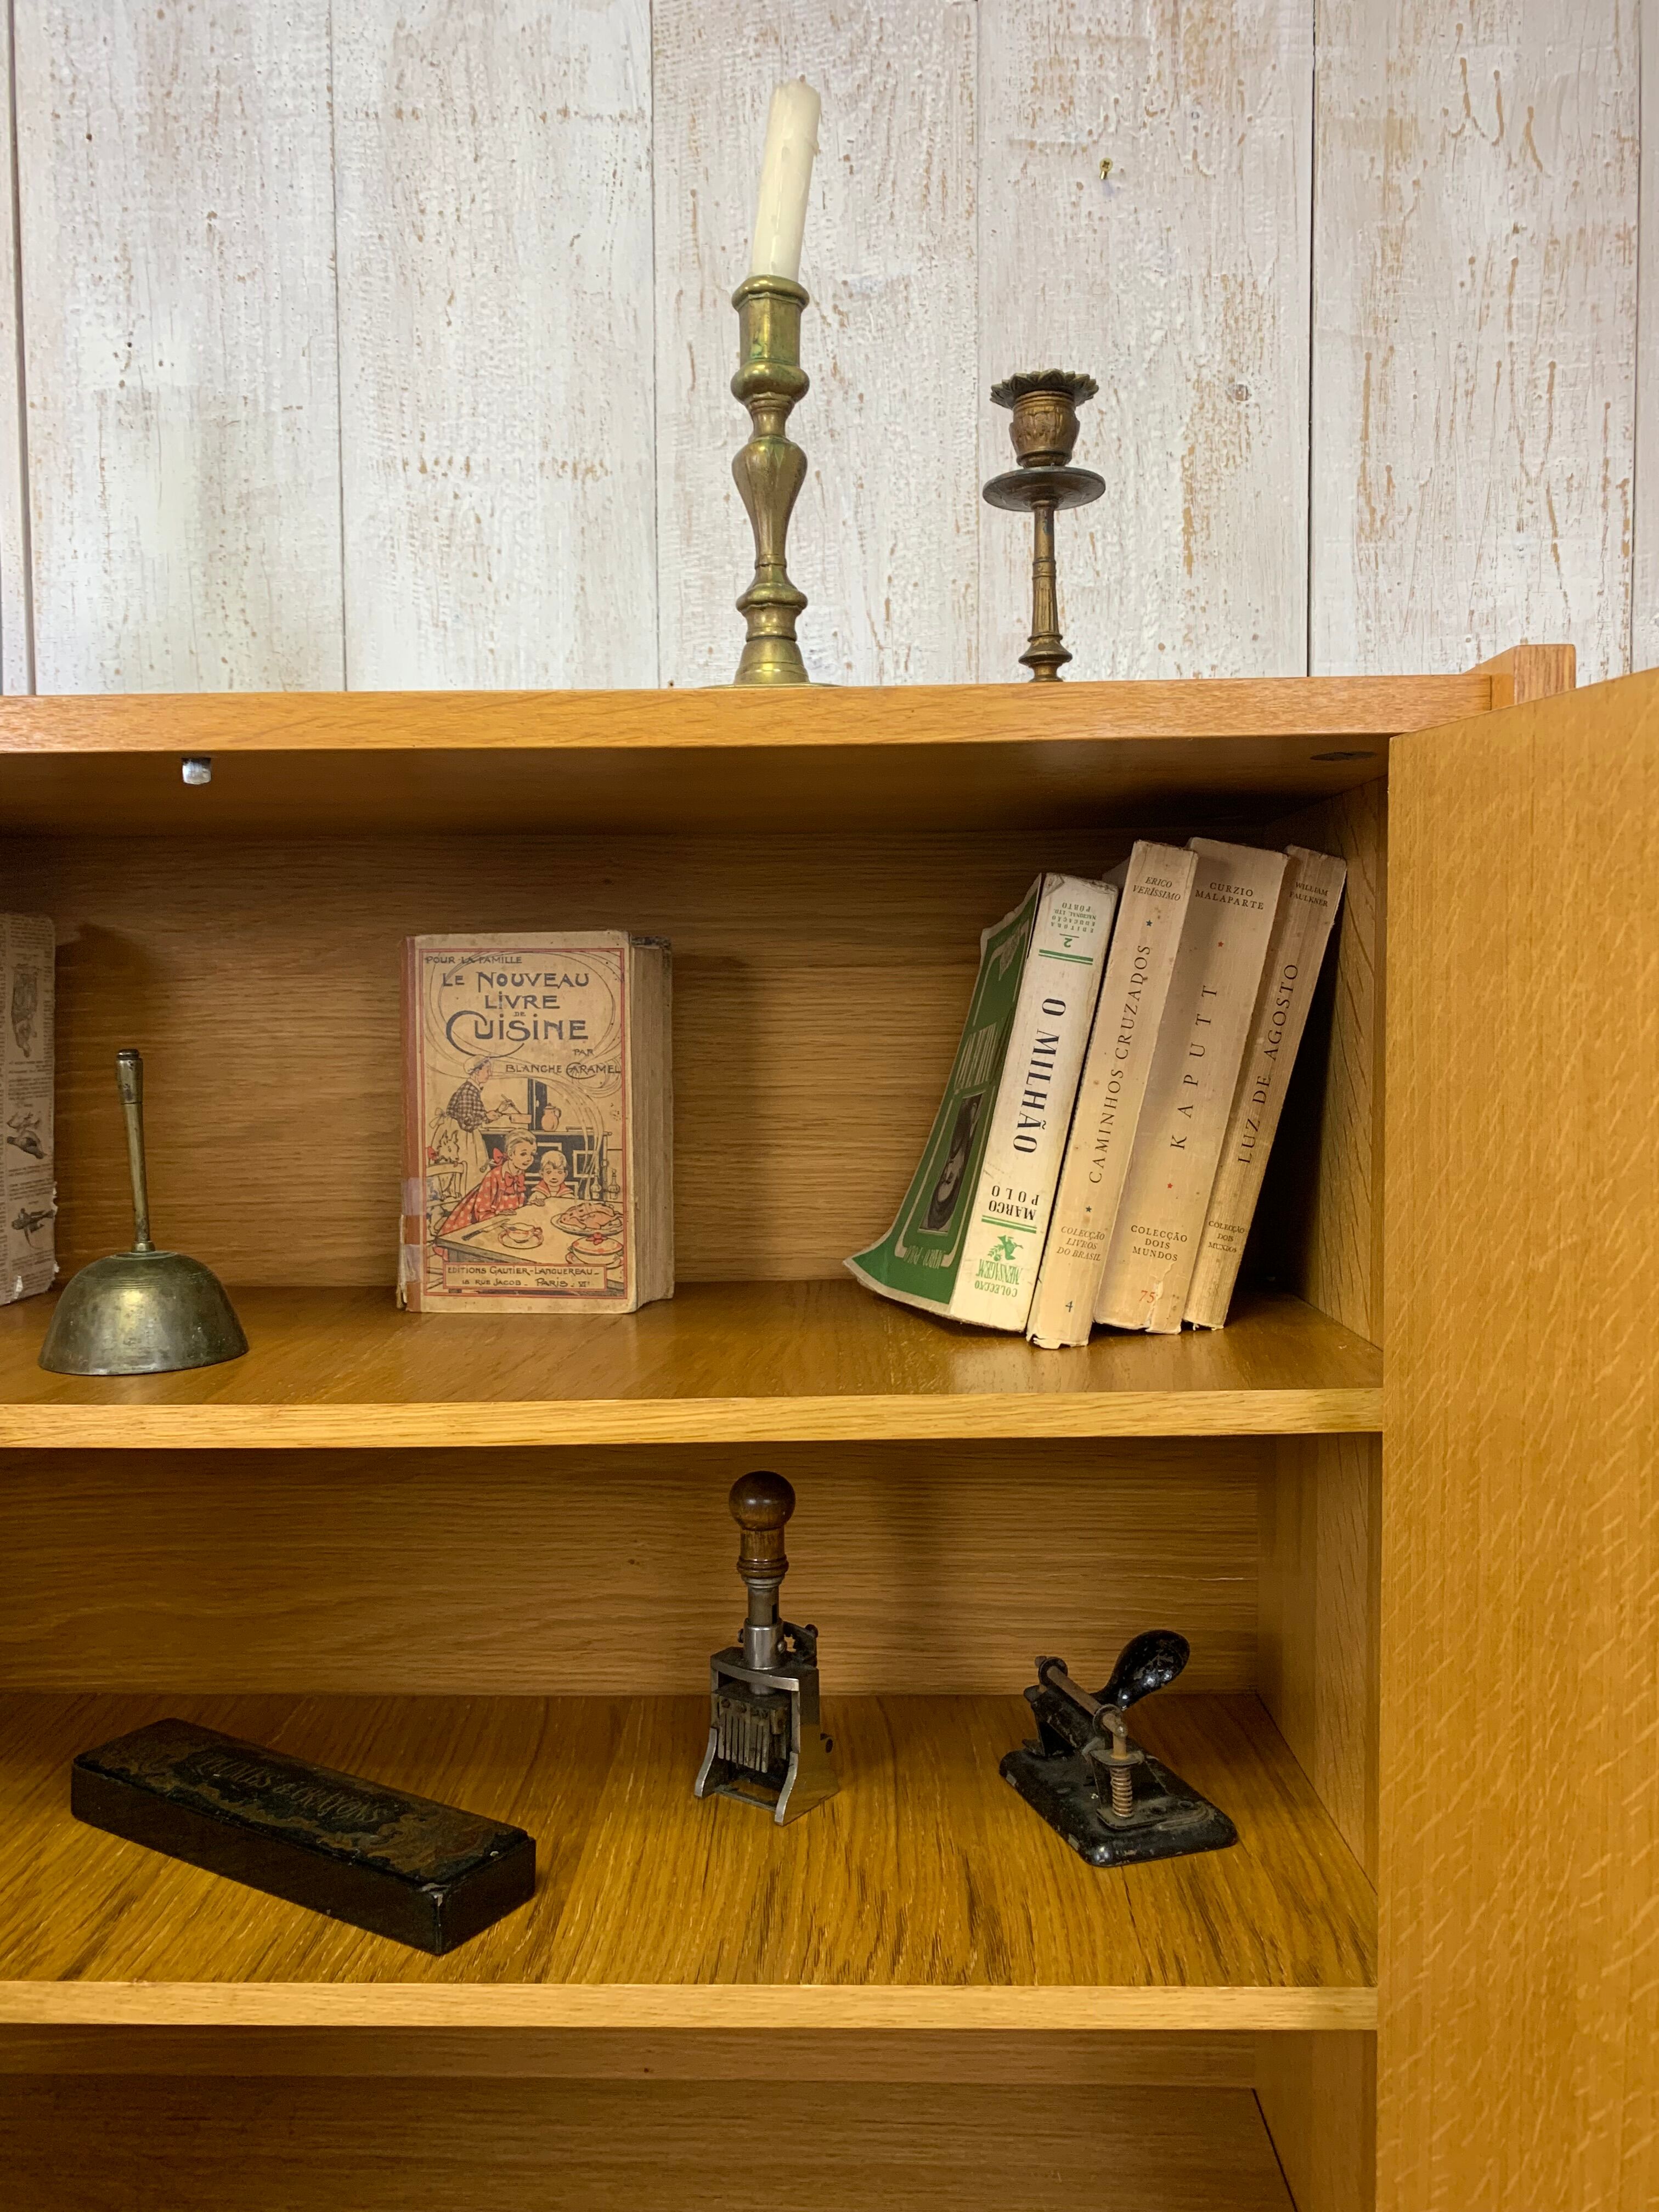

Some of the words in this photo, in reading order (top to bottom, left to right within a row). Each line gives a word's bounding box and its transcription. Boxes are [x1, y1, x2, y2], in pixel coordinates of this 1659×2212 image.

[1144, 876, 1172, 888] ERICO
[1209, 882, 1254, 897] CURZIO
[1295, 881, 1329, 896] WILLIAM
[1132, 884, 1181, 901] VERÍSSIMO
[1195, 889, 1264, 910] MALAPARTE
[1289, 891, 1328, 907] FAULKNER
[1069, 911, 1097, 920] NACIONAL
[1051, 922, 1094, 933] EDITORA
[1063, 937, 1073, 948] 2
[425, 956, 455, 964] POUR
[442, 973, 465, 987] LE
[476, 972, 590, 993] NOUVEAU
[484, 991, 560, 1009] LIVRE
[1042, 998, 1066, 1016] O
[445, 1010, 589, 1058] CUISINE
[573, 1048, 595, 1057] PAR
[505, 1064, 562, 1073] BLANCHE
[1088, 1068, 1124, 1183] CAMINHOS
[1114, 945, 1150, 1059] CRUZADOS
[1238, 1118, 1261, 1164] LUZ
[1252, 1075, 1272, 1104] DE
[1263, 964, 1298, 1061] AGOSTO
[1013, 1028, 1060, 1153] MILHÃO
[991, 1185, 1040, 1206] POLO
[989, 1200, 1037, 1221] MARCO
[1060, 1225, 1105, 1241] COLECÇÃO
[1130, 1224, 1188, 1243] COLECÇÃO
[1216, 1233, 1234, 1242] DOIS
[1065, 1238, 1098, 1250] LIVROS
[1144, 1238, 1171, 1250] DOIS
[1207, 1242, 1238, 1254] MUNDOS
[1056, 1246, 1071, 1256] DO
[1071, 1249, 1102, 1262] BRASIL
[1132, 1245, 1178, 1262] MUNDOS
[448, 1265, 487, 1273] EDITIONS
[975, 1259, 1023, 1285] MENSAGEM
[493, 1278, 521, 1286] JACOB
[534, 1277, 568, 1288] PARIS
[1139, 1290, 1156, 1304] 75
[1065, 1301, 1074, 1313] 4
